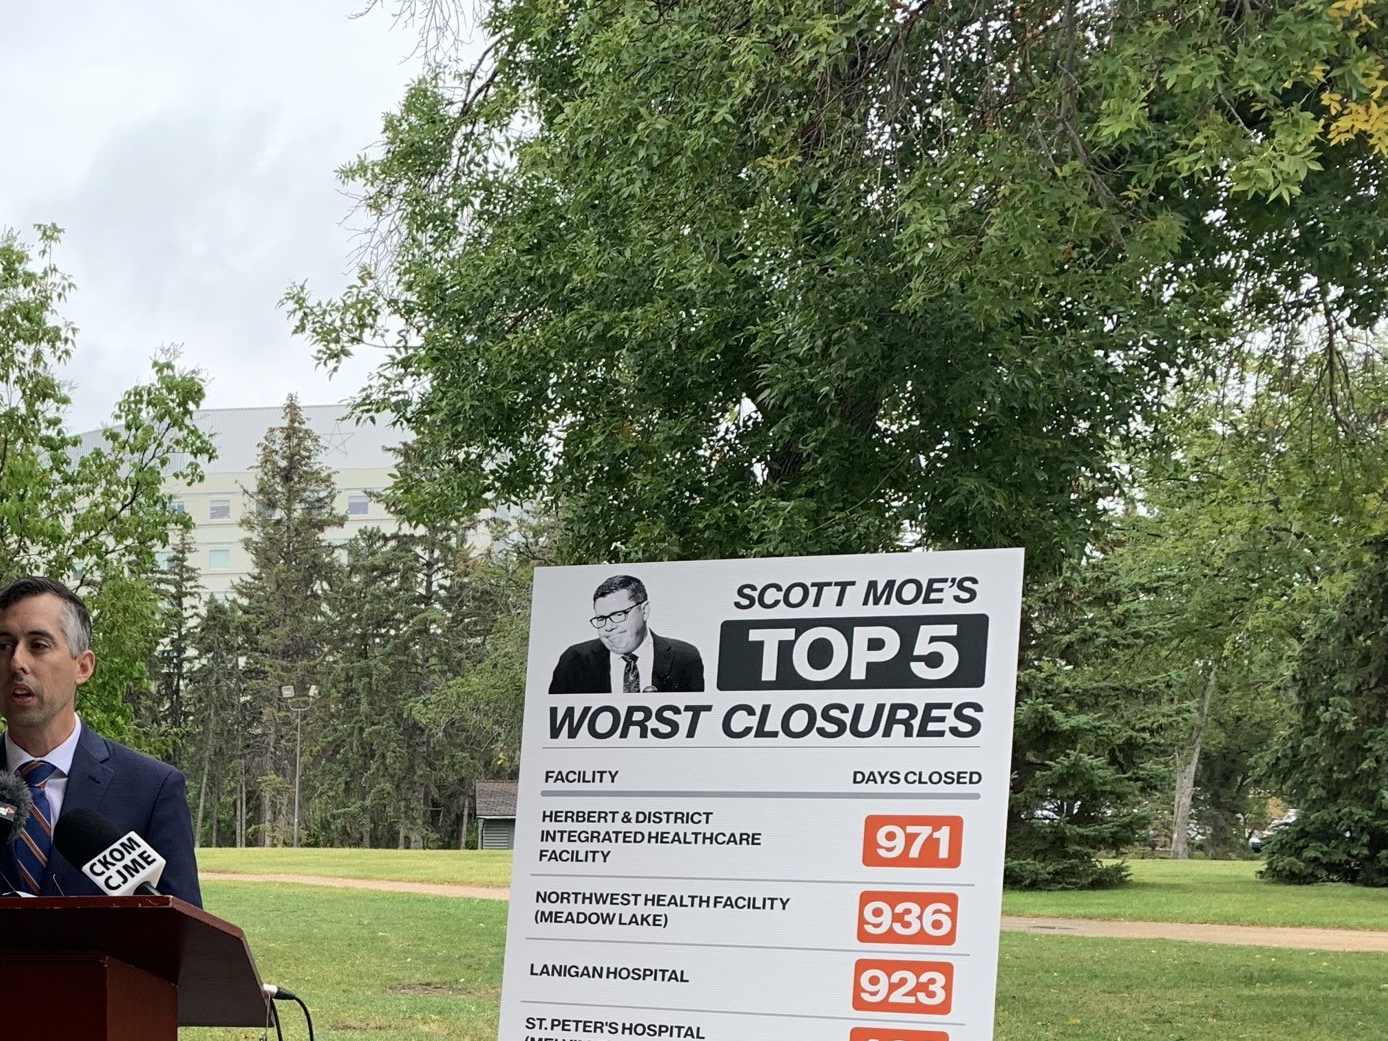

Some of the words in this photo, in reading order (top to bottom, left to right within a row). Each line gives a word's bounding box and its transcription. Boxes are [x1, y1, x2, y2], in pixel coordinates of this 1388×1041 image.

[734, 581, 856, 609] SCOTT
[862, 577, 978, 606] MOE'S
[749, 626, 900, 681] TOP
[910, 625, 959, 679] 5
[550, 705, 713, 739] WORST
[722, 702, 983, 739] CLOSURES
[545, 771, 619, 783] FACILITY
[853, 771, 900, 784] DAYS
[904, 771, 982, 784] CLOSED
[542, 811, 619, 823] HERBERT
[621, 811, 632, 823] &
[636, 812, 713, 824] DISTRICT
[541, 830, 645, 843] INTEGRATED
[648, 832, 761, 845] HEALTHCARE
[877, 825, 950, 858] 971
[89, 836, 142, 877] CKOM
[539, 850, 611, 862] FACILITY
[103, 850, 157, 891] CJME
[536, 891, 641, 906] NORTHWEST
[644, 894, 710, 908] HEALTH
[714, 896, 790, 910] FACILITY
[535, 910, 616, 925] (MEADOW
[619, 913, 668, 928] LAKE)
[864, 901, 951, 936] 936
[530, 964, 603, 978] LANIGAN
[606, 967, 689, 982] HOSPITAL
[860, 969, 945, 1005] 923
[526, 1017, 547, 1030] ST.
[551, 1019, 618, 1034] PETER'S
[622, 1023, 705, 1039] HOSPITAL
